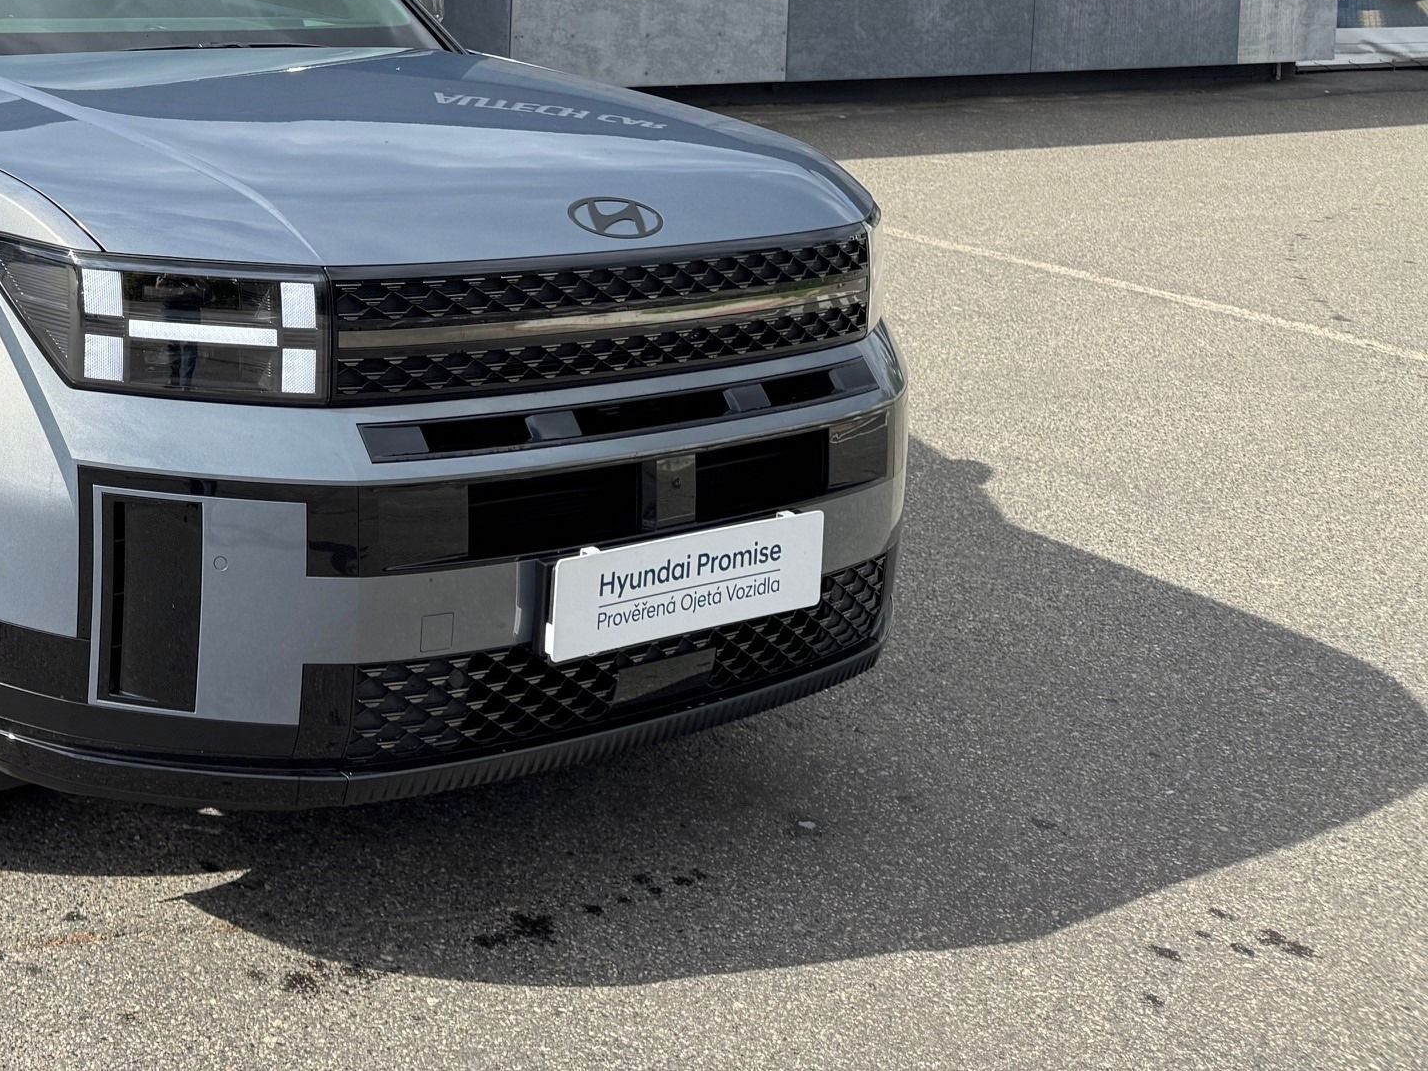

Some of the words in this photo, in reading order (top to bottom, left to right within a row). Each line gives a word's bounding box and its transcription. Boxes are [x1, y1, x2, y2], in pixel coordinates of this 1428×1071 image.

[598, 554, 691, 598] Hyundai
[697, 541, 782, 576] Promise
[597, 596, 676, 630] Prověřená
[680, 585, 722, 613] Ojetá
[726, 576, 780, 602] Vozidla
